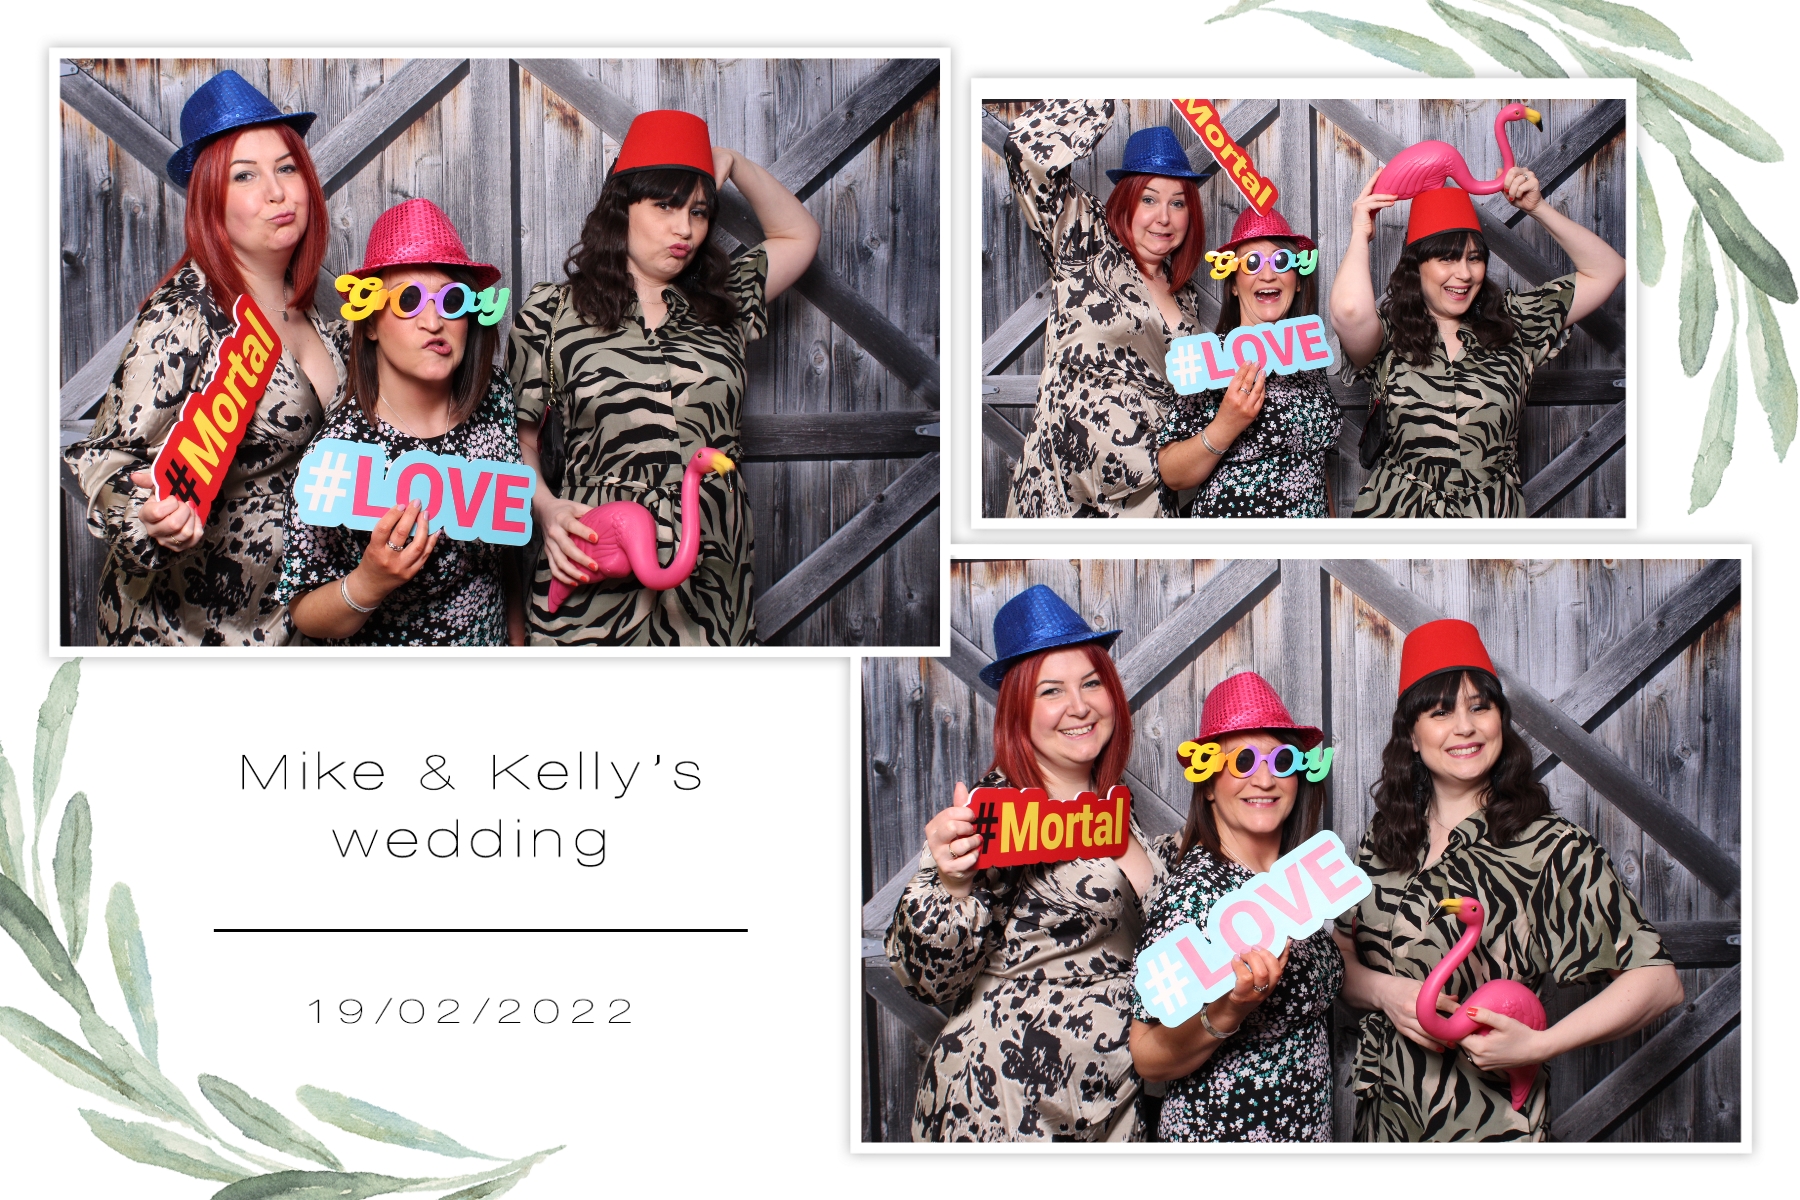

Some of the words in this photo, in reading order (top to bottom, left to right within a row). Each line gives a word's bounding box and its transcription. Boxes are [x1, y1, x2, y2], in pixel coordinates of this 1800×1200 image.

[1171, 321, 1329, 387] #LOVE
[164, 306, 275, 507] #Mortal
[303, 450, 530, 534] #LOVE
[972, 797, 1124, 855] #Mortal
[1144, 839, 1363, 1016] #LOVE
